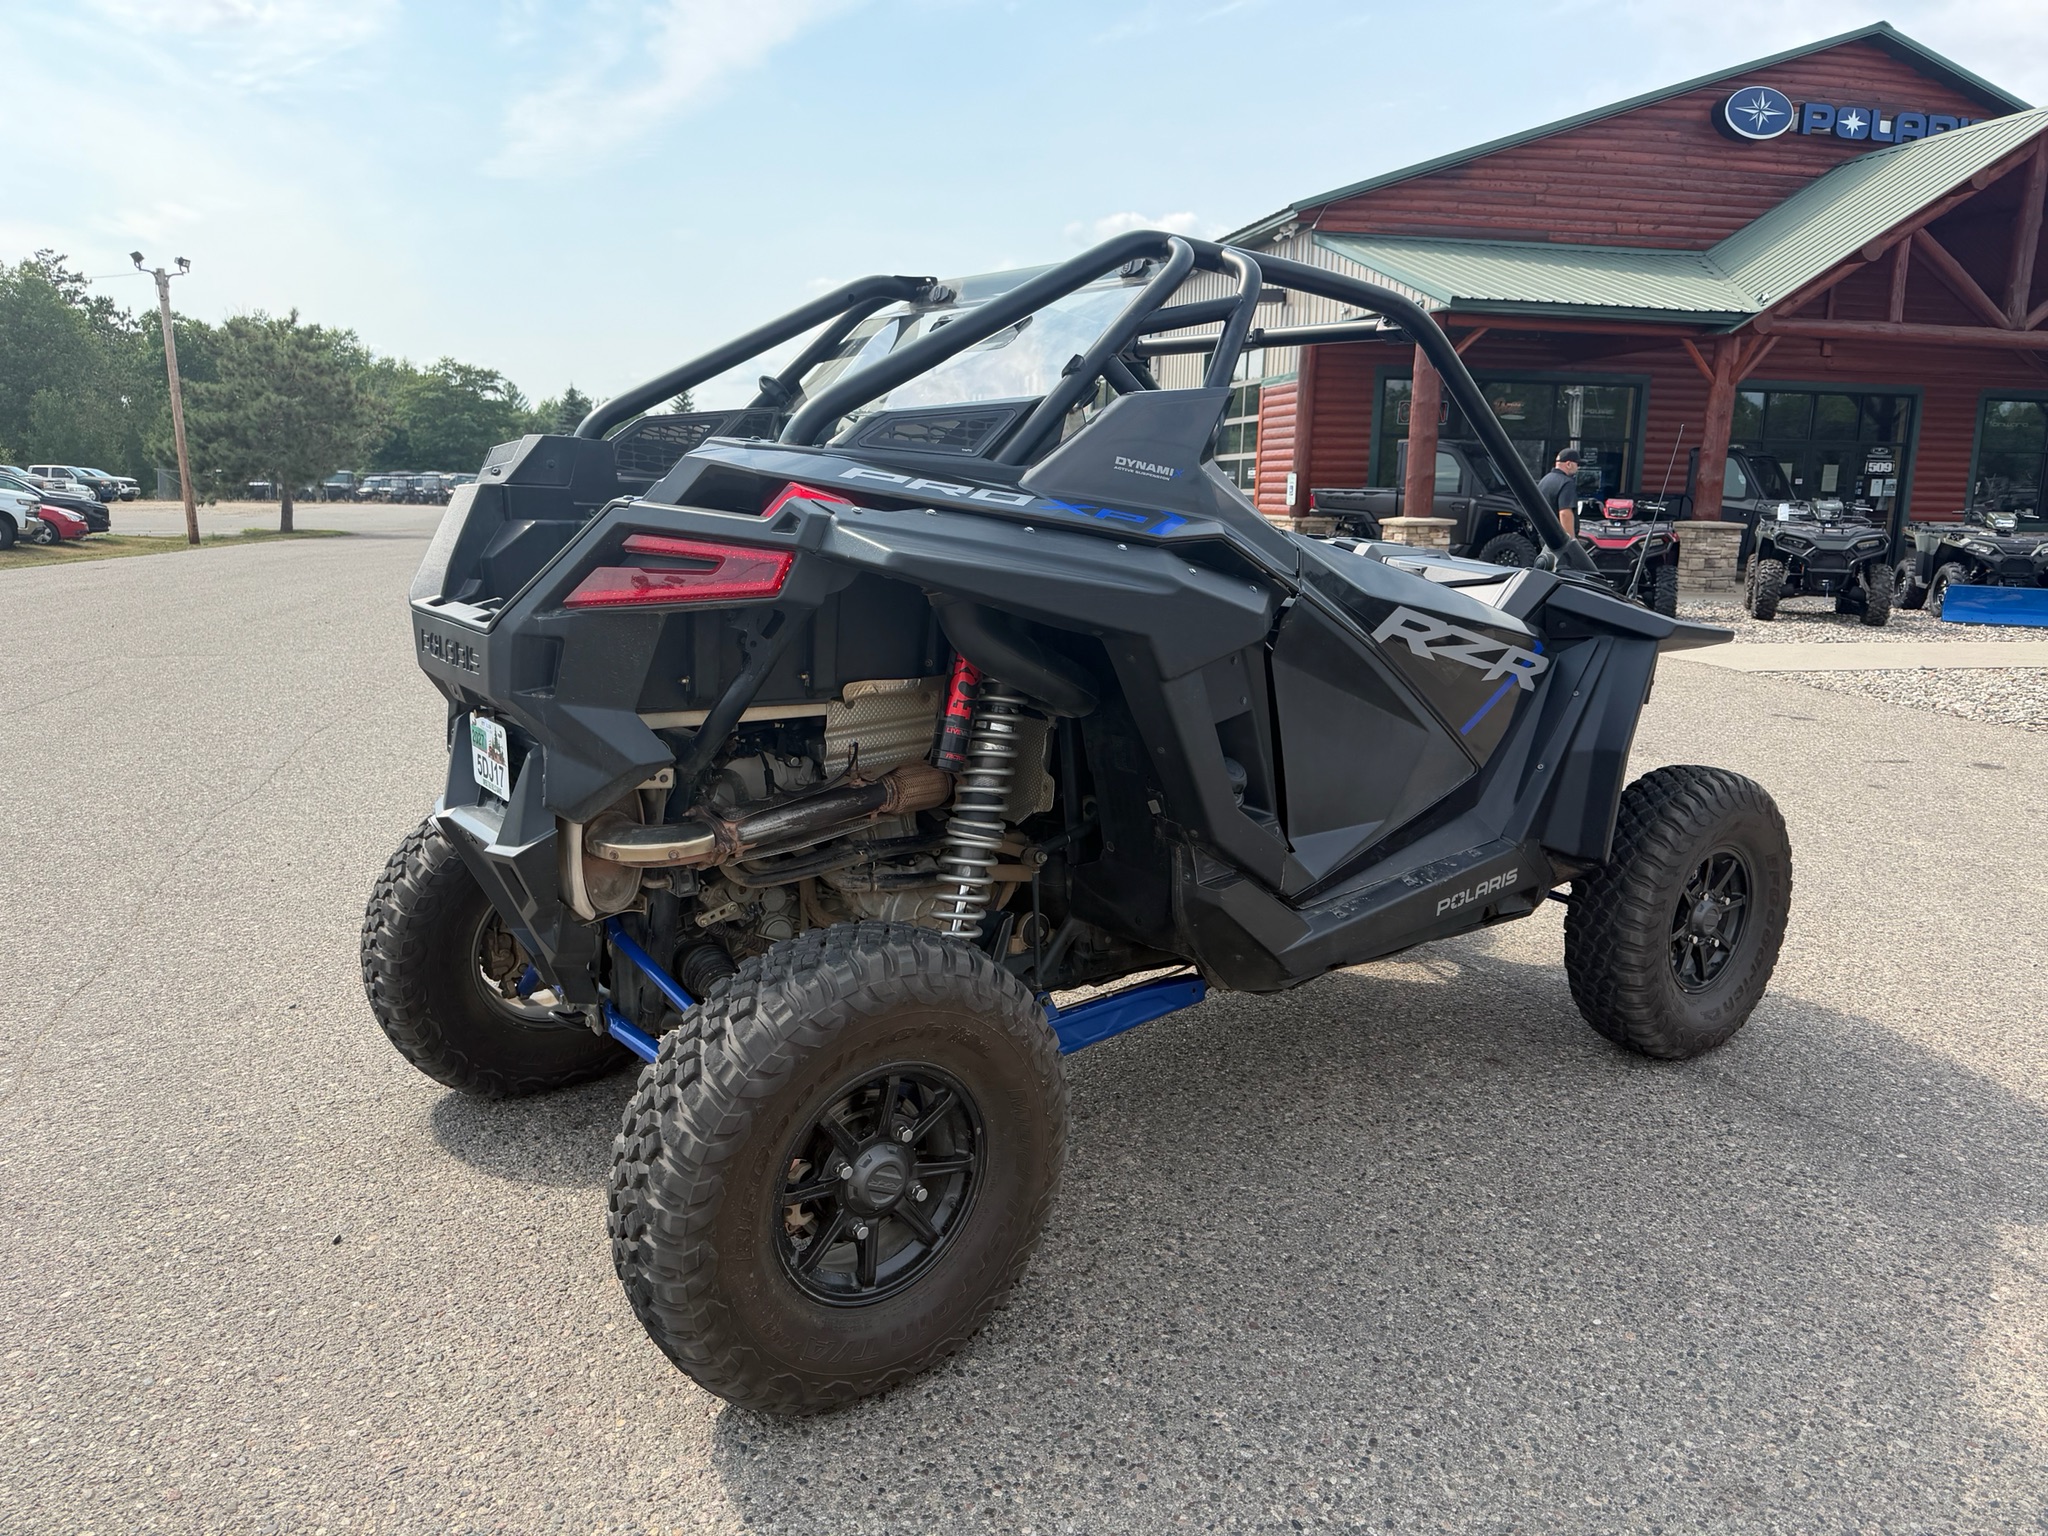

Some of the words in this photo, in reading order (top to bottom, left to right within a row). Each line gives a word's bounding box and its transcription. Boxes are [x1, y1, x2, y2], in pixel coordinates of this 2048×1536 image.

[1801, 103, 1987, 143] POLAR
[837, 467, 1037, 507] PRO
[1868, 462, 1893, 473] 509
[421, 629, 479, 675] POLARIS
[1370, 605, 1550, 693] RZR
[477, 754, 504, 787] 5DJ17
[1436, 867, 1519, 917] POLARIS
